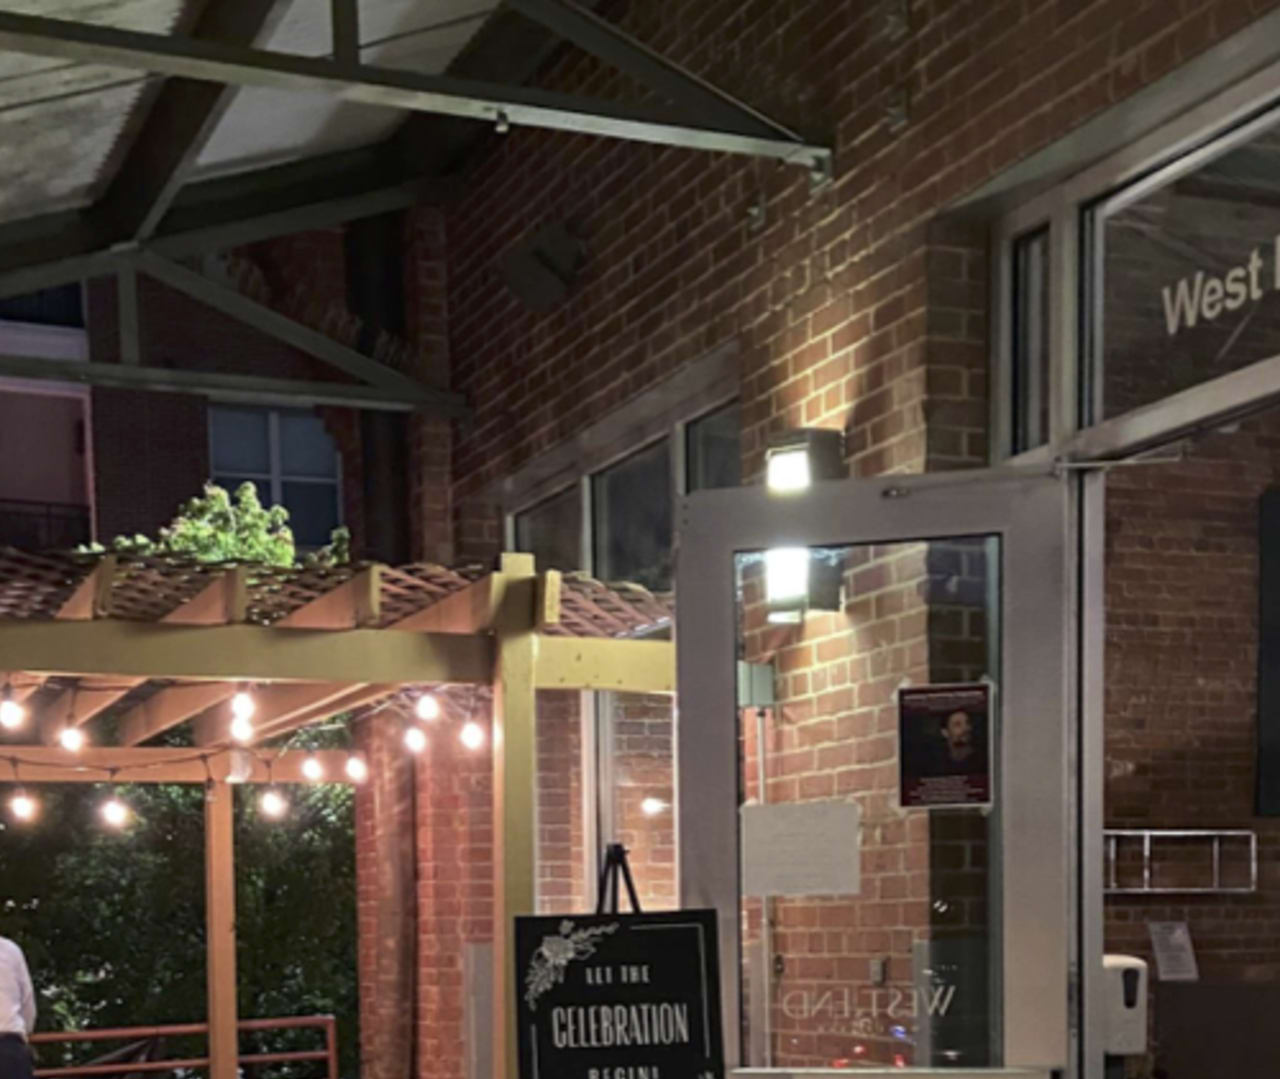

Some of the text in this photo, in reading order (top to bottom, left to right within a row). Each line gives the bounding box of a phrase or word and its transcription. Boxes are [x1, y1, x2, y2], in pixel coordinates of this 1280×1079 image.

[1162, 247, 1264, 336] West
[585, 964, 651, 985] LET THE
[551, 1002, 690, 1049] CELEBRATION
